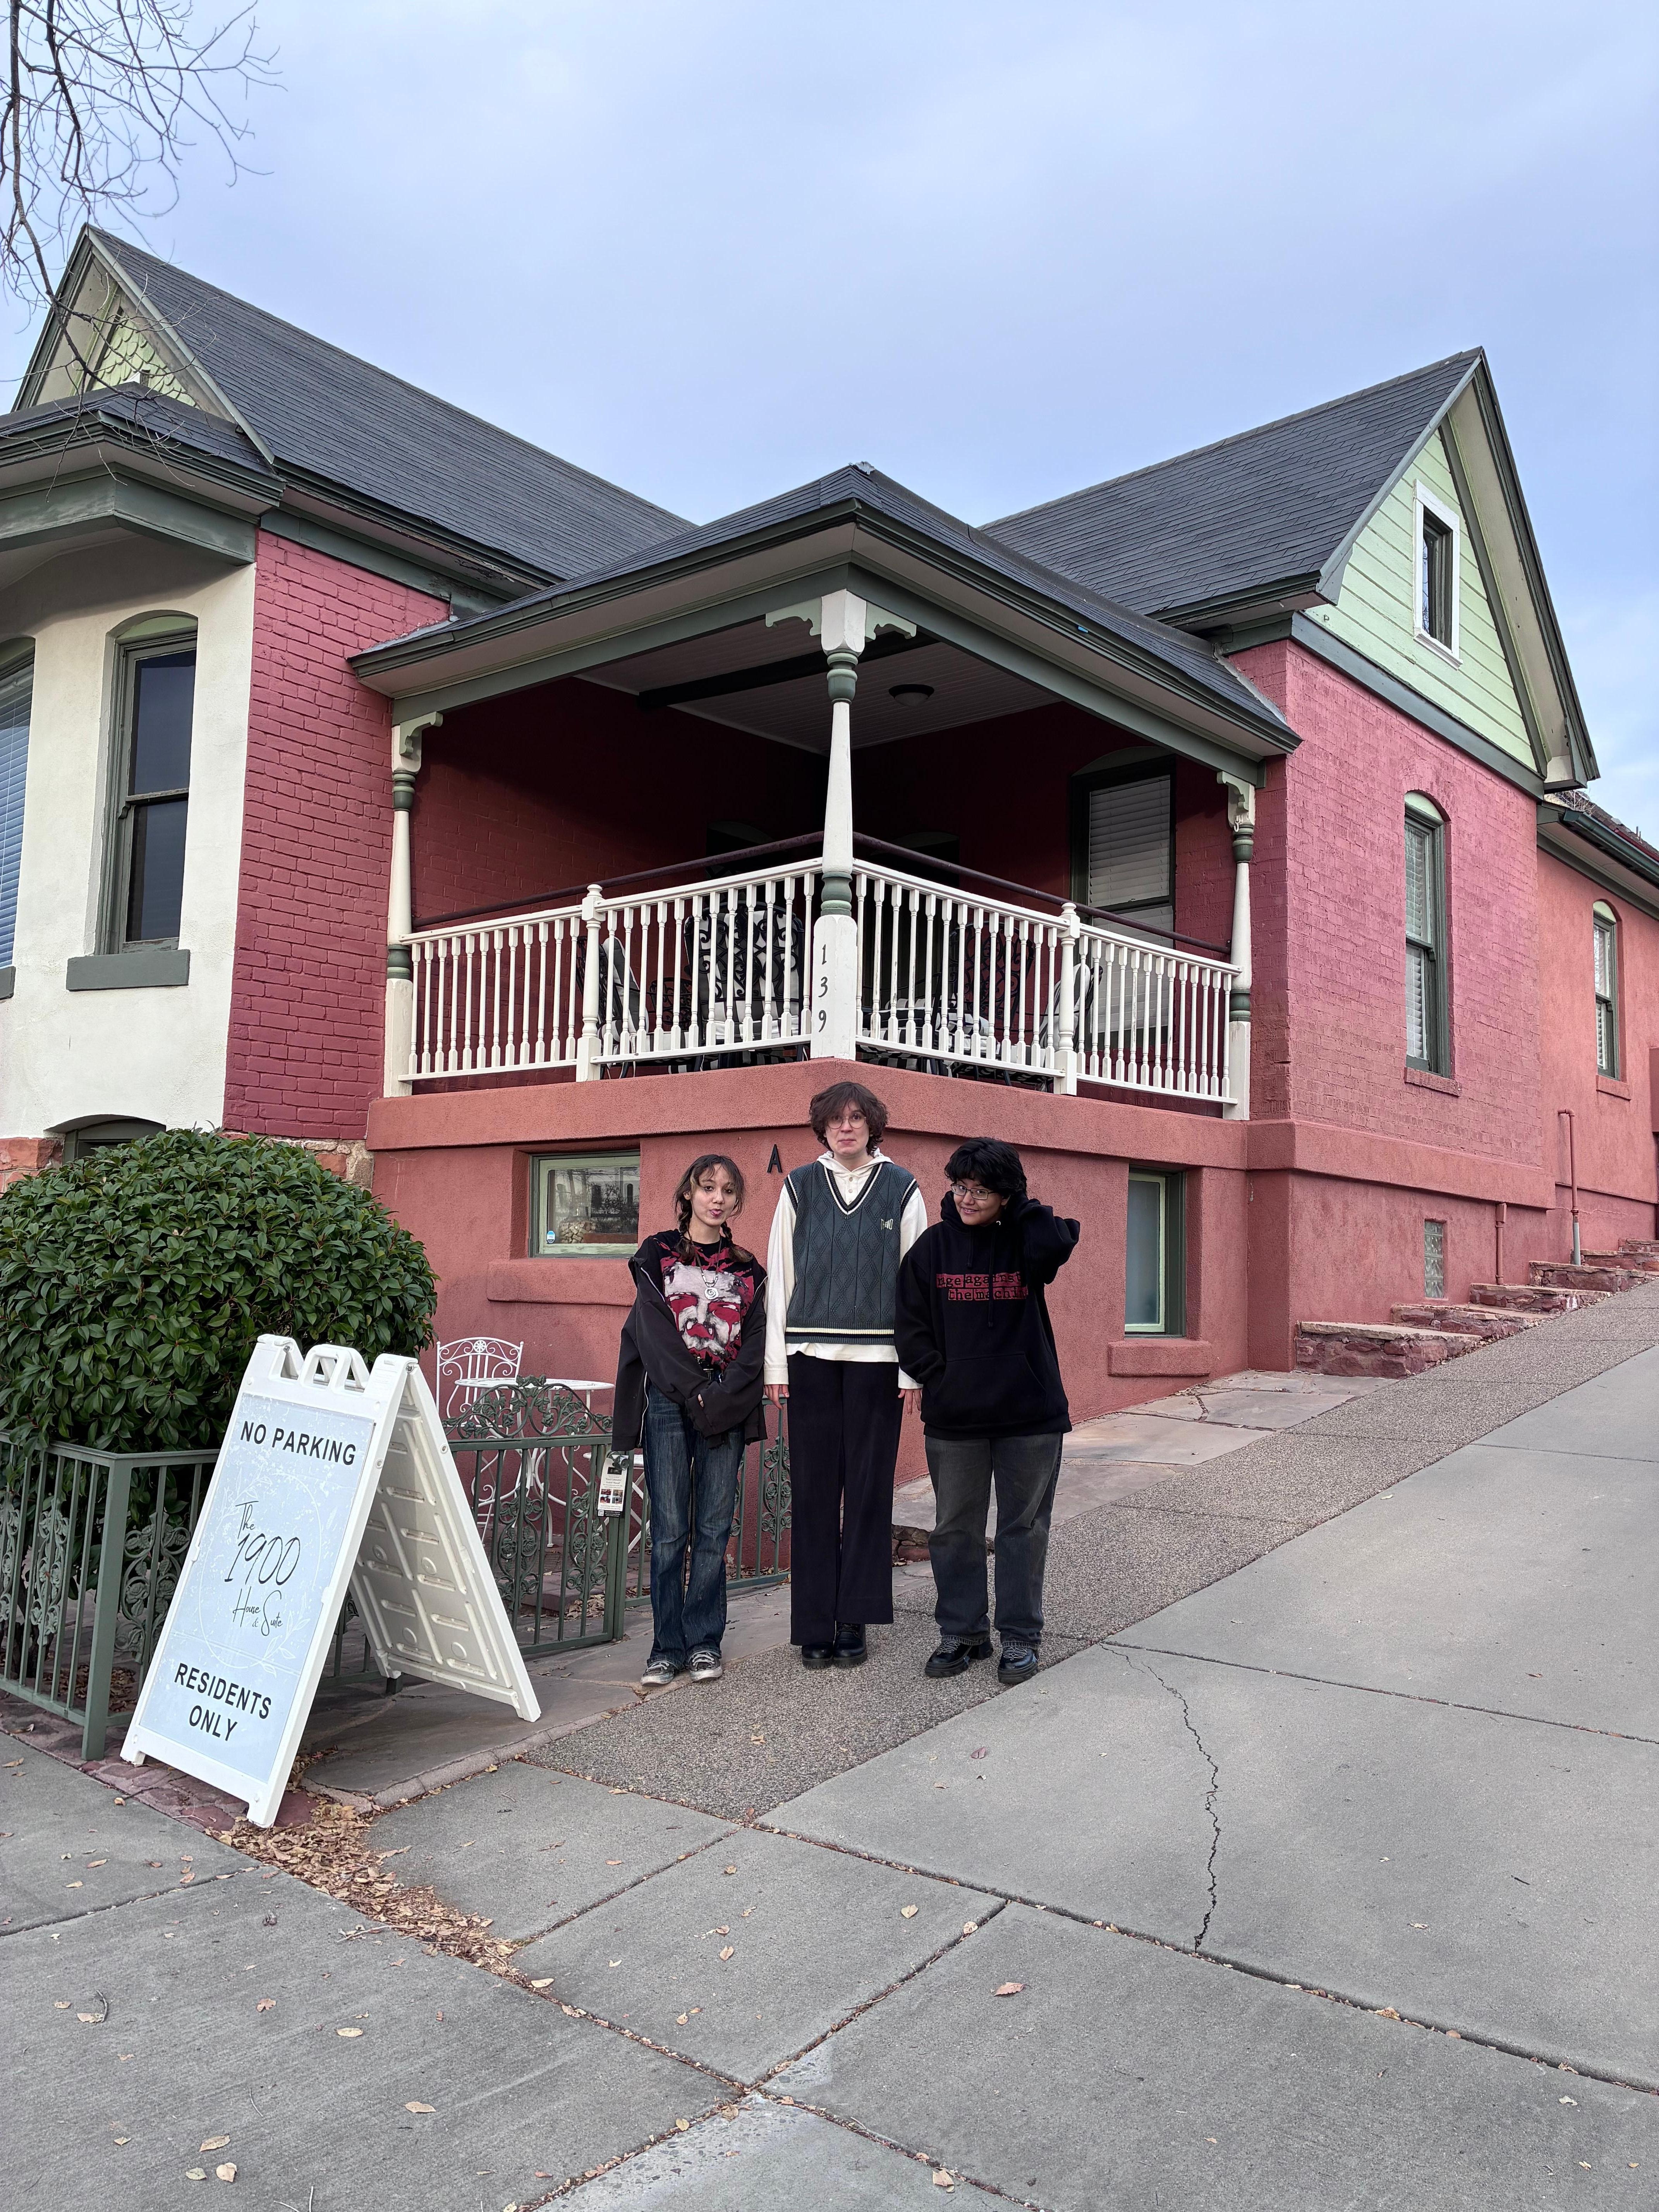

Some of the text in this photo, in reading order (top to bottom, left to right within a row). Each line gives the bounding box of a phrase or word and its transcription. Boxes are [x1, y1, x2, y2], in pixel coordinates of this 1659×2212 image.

[767, 1144, 782, 1173] A
[949, 1289, 971, 1300] the
[240, 1421, 356, 1465] NO PARKING
[235, 1501, 259, 1539] The
[225, 1533, 300, 1585] 1900
[232, 1586, 260, 1627] House
[261, 1590, 283, 1636] Suite
[174, 1663, 271, 1719] RESIDENTS
[189, 1705, 238, 1741] ONLY
